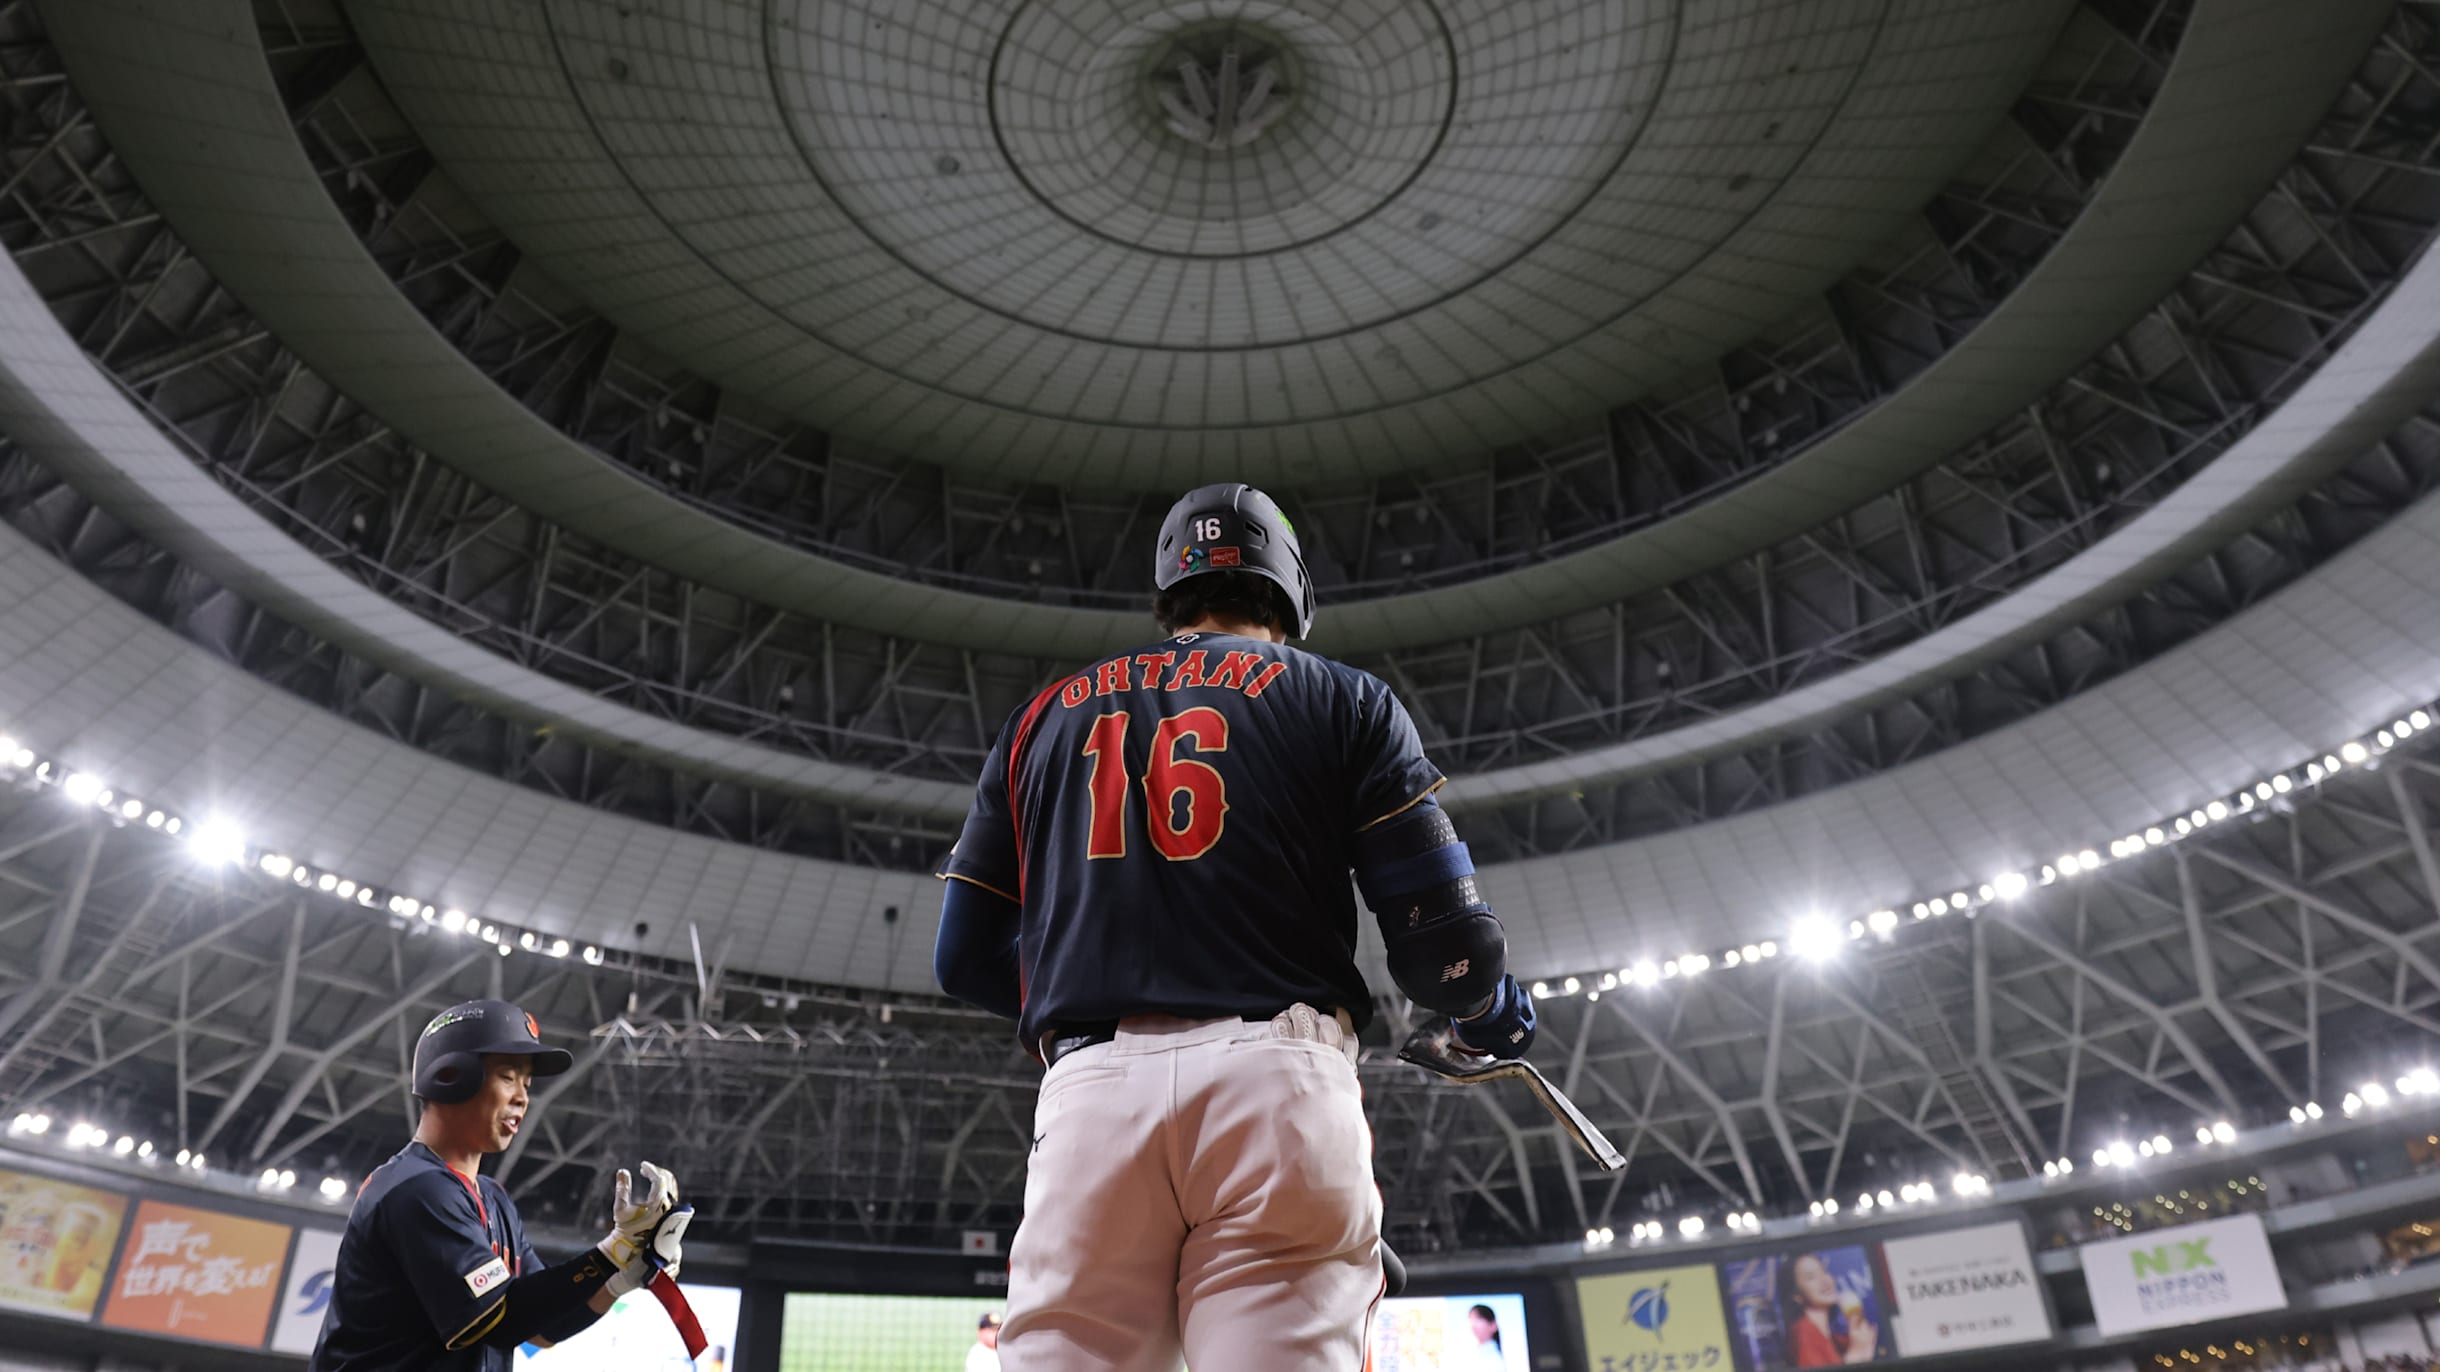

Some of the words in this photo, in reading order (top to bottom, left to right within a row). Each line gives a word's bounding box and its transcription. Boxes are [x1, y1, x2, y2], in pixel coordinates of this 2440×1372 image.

[1194, 518, 1221, 542] 16
[1061, 650, 1287, 708] OHTANI
[1082, 706, 1230, 861] 16
[131, 1218, 213, 1266] 声で
[2128, 1236, 2218, 1279] NX
[1906, 1269, 2028, 1301] TAKENAKA
[2137, 1271, 2226, 1298] NIPPON
[1599, 1346, 1720, 1372] エイジェック
